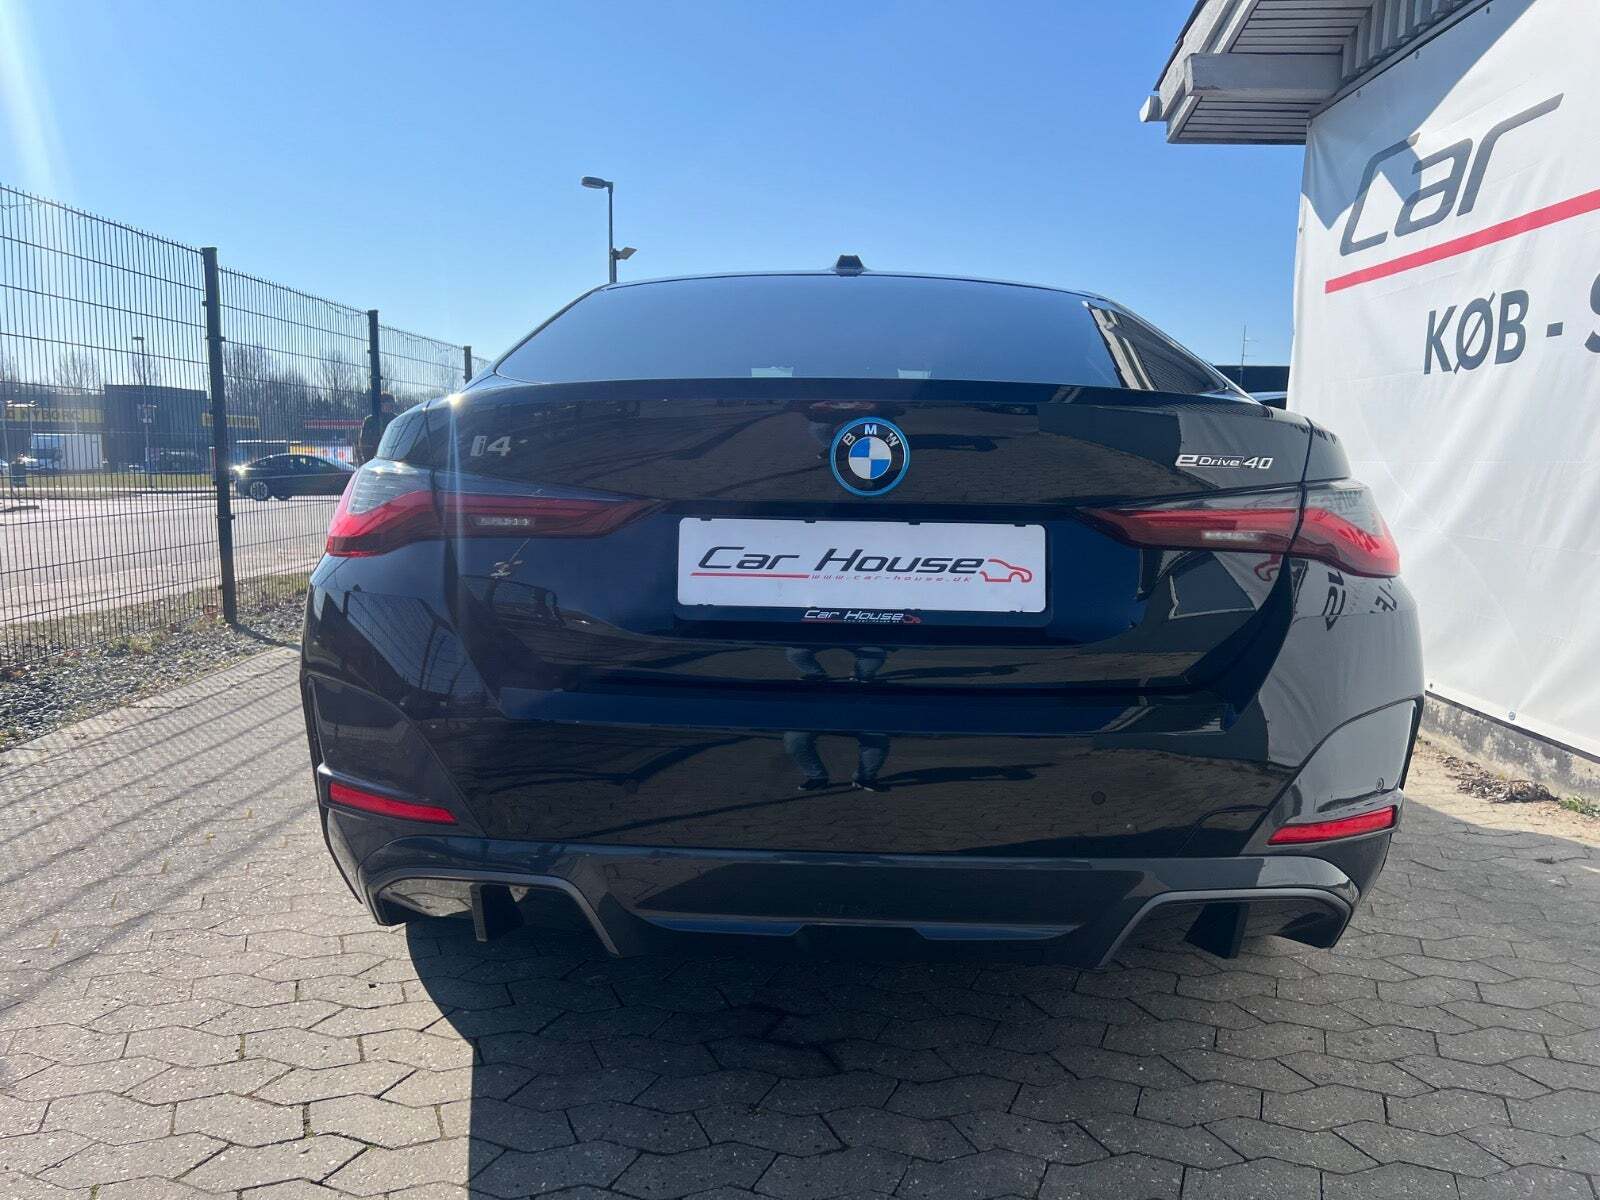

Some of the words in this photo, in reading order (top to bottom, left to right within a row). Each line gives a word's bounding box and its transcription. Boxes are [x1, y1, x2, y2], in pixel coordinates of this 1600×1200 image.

[1339, 92, 1564, 257] Car
[1423, 289, 1530, 375] KØB
[470, 435, 512, 457] i4
[842, 423, 900, 447] BMW
[698, 546, 800, 570] Car
[814, 548, 985, 574] House
[803, 609, 840, 619] Car
[844, 610, 905, 621] House
